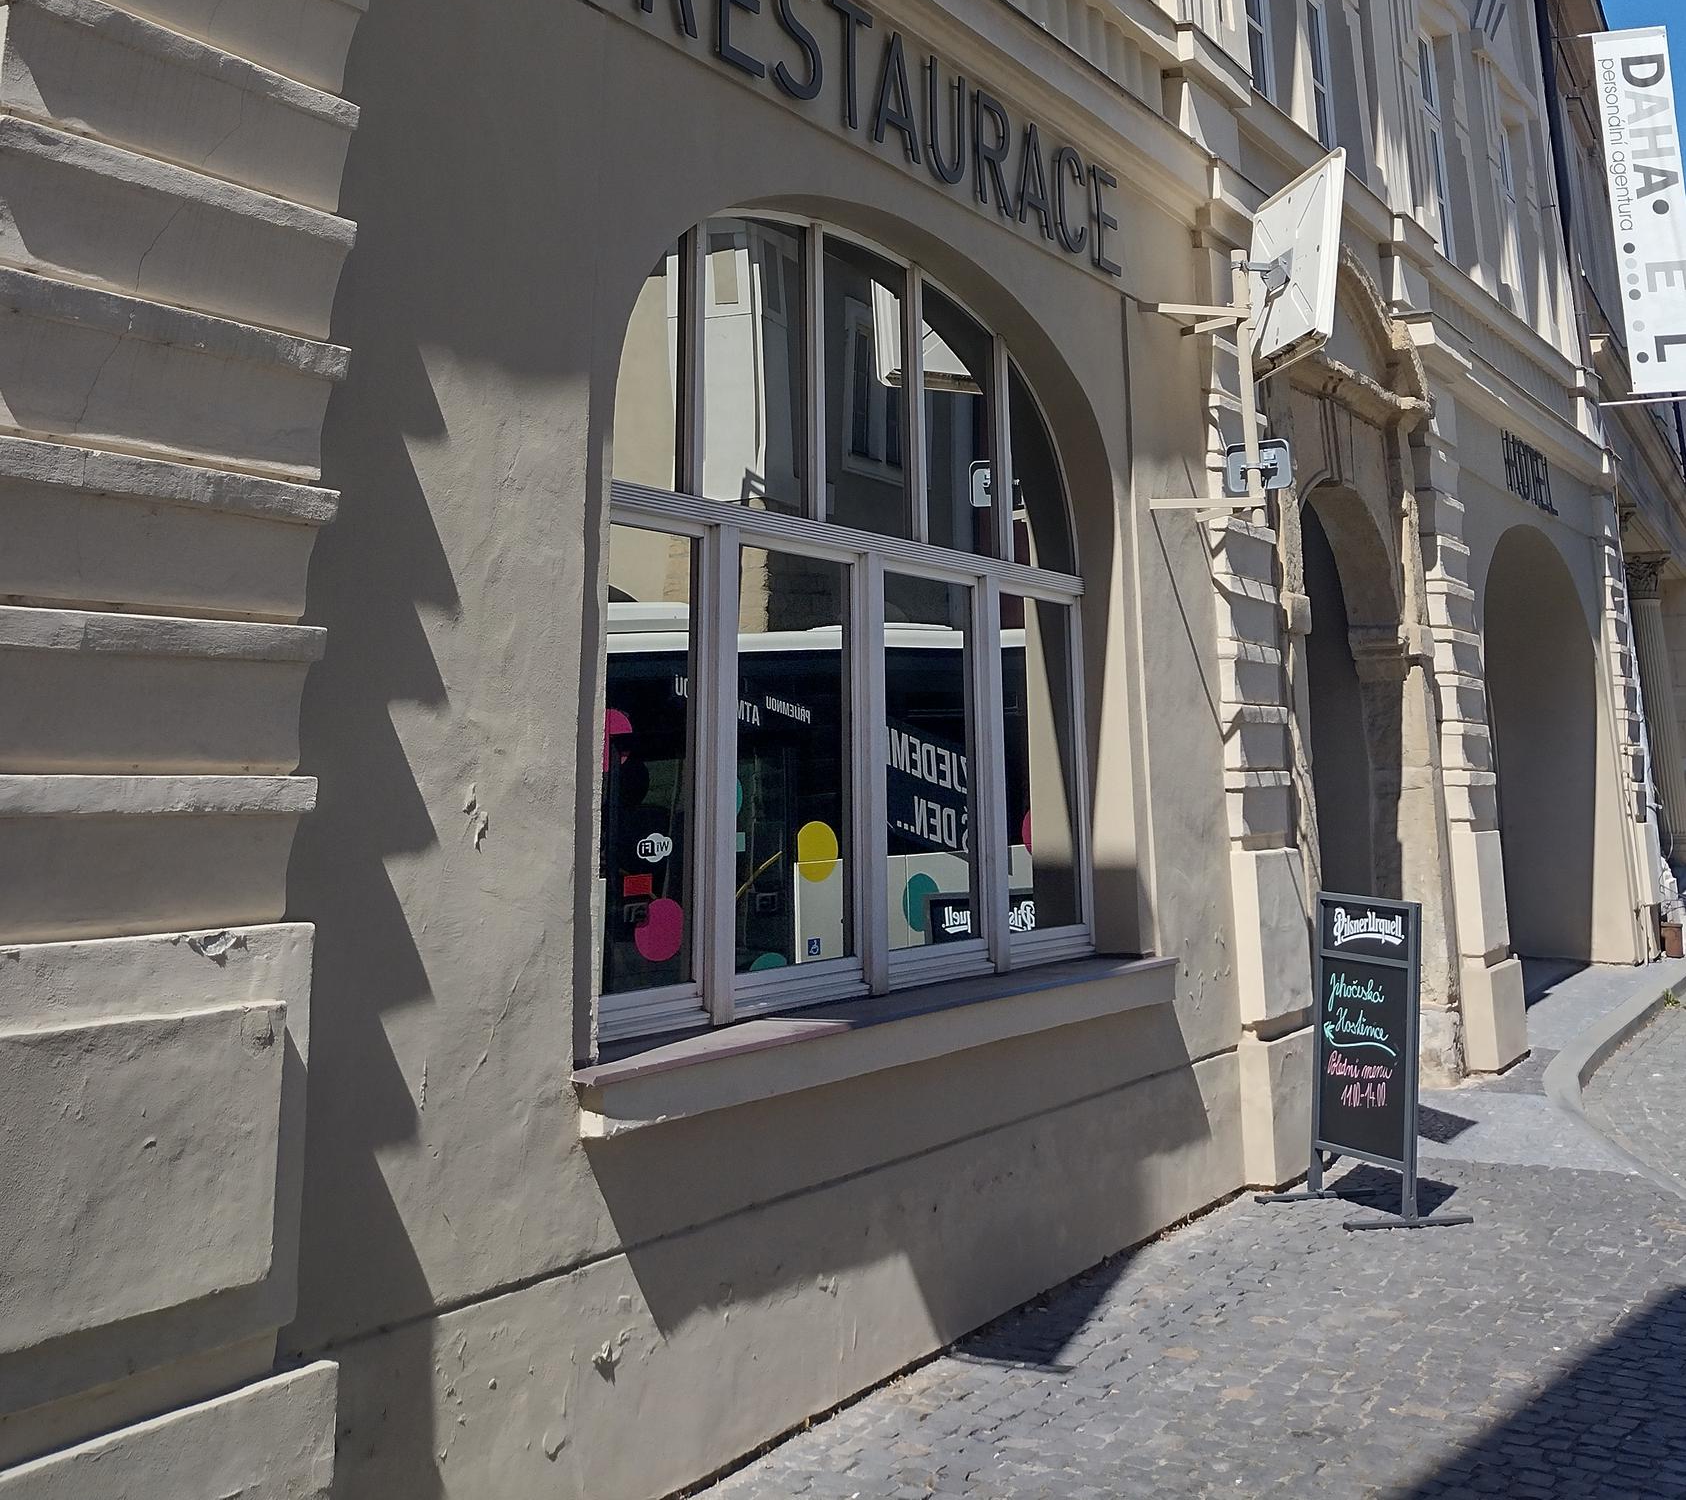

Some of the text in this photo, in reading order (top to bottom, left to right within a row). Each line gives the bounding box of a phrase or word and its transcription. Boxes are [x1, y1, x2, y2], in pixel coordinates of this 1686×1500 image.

[1597, 57, 1634, 231] personální agentura
[1621, 53, 1679, 200] DAHA
[1500, 428, 1559, 517] HOTEL
[1333, 906, 1369, 947] Pilsner
[1327, 1049, 1360, 1079] Polední
